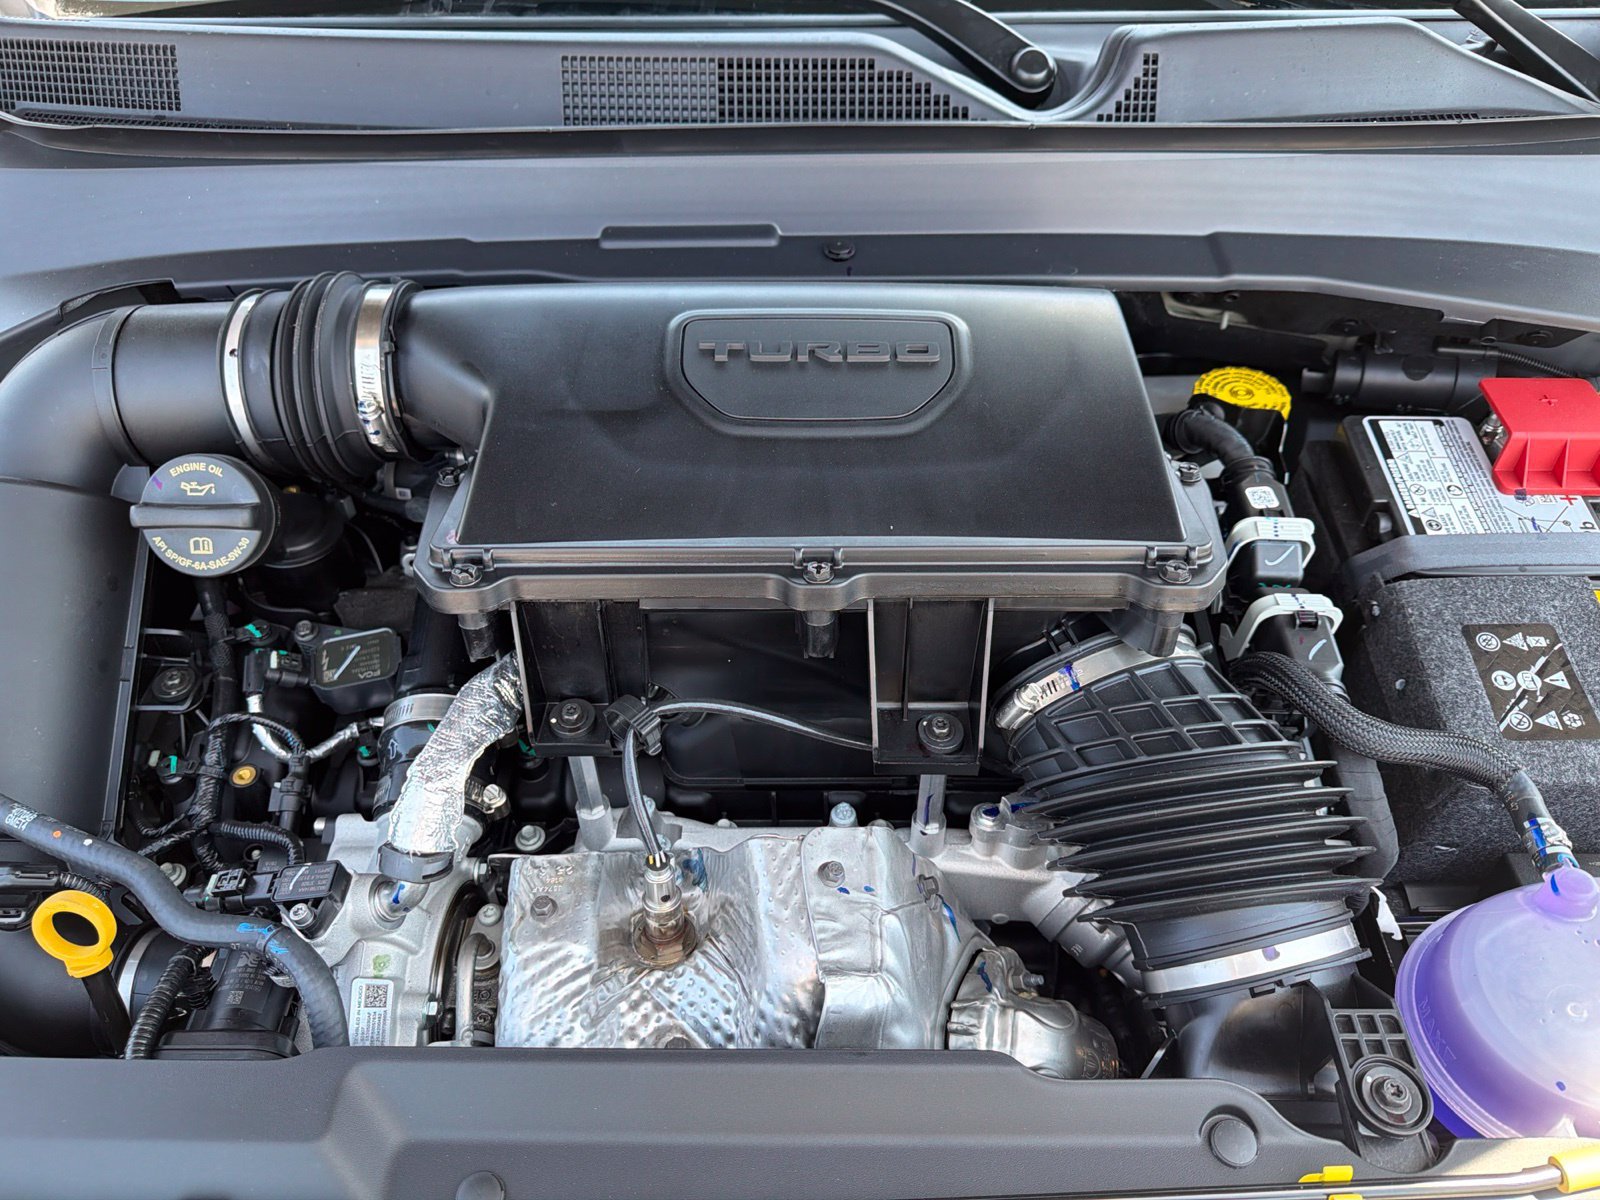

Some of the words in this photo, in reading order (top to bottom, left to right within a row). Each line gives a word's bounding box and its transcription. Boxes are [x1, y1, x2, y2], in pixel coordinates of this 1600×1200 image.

[698, 340, 942, 363] TURBO
[169, 462, 206, 477] ENGINE
[208, 463, 224, 478] OIL
[153, 537, 167, 551] API
